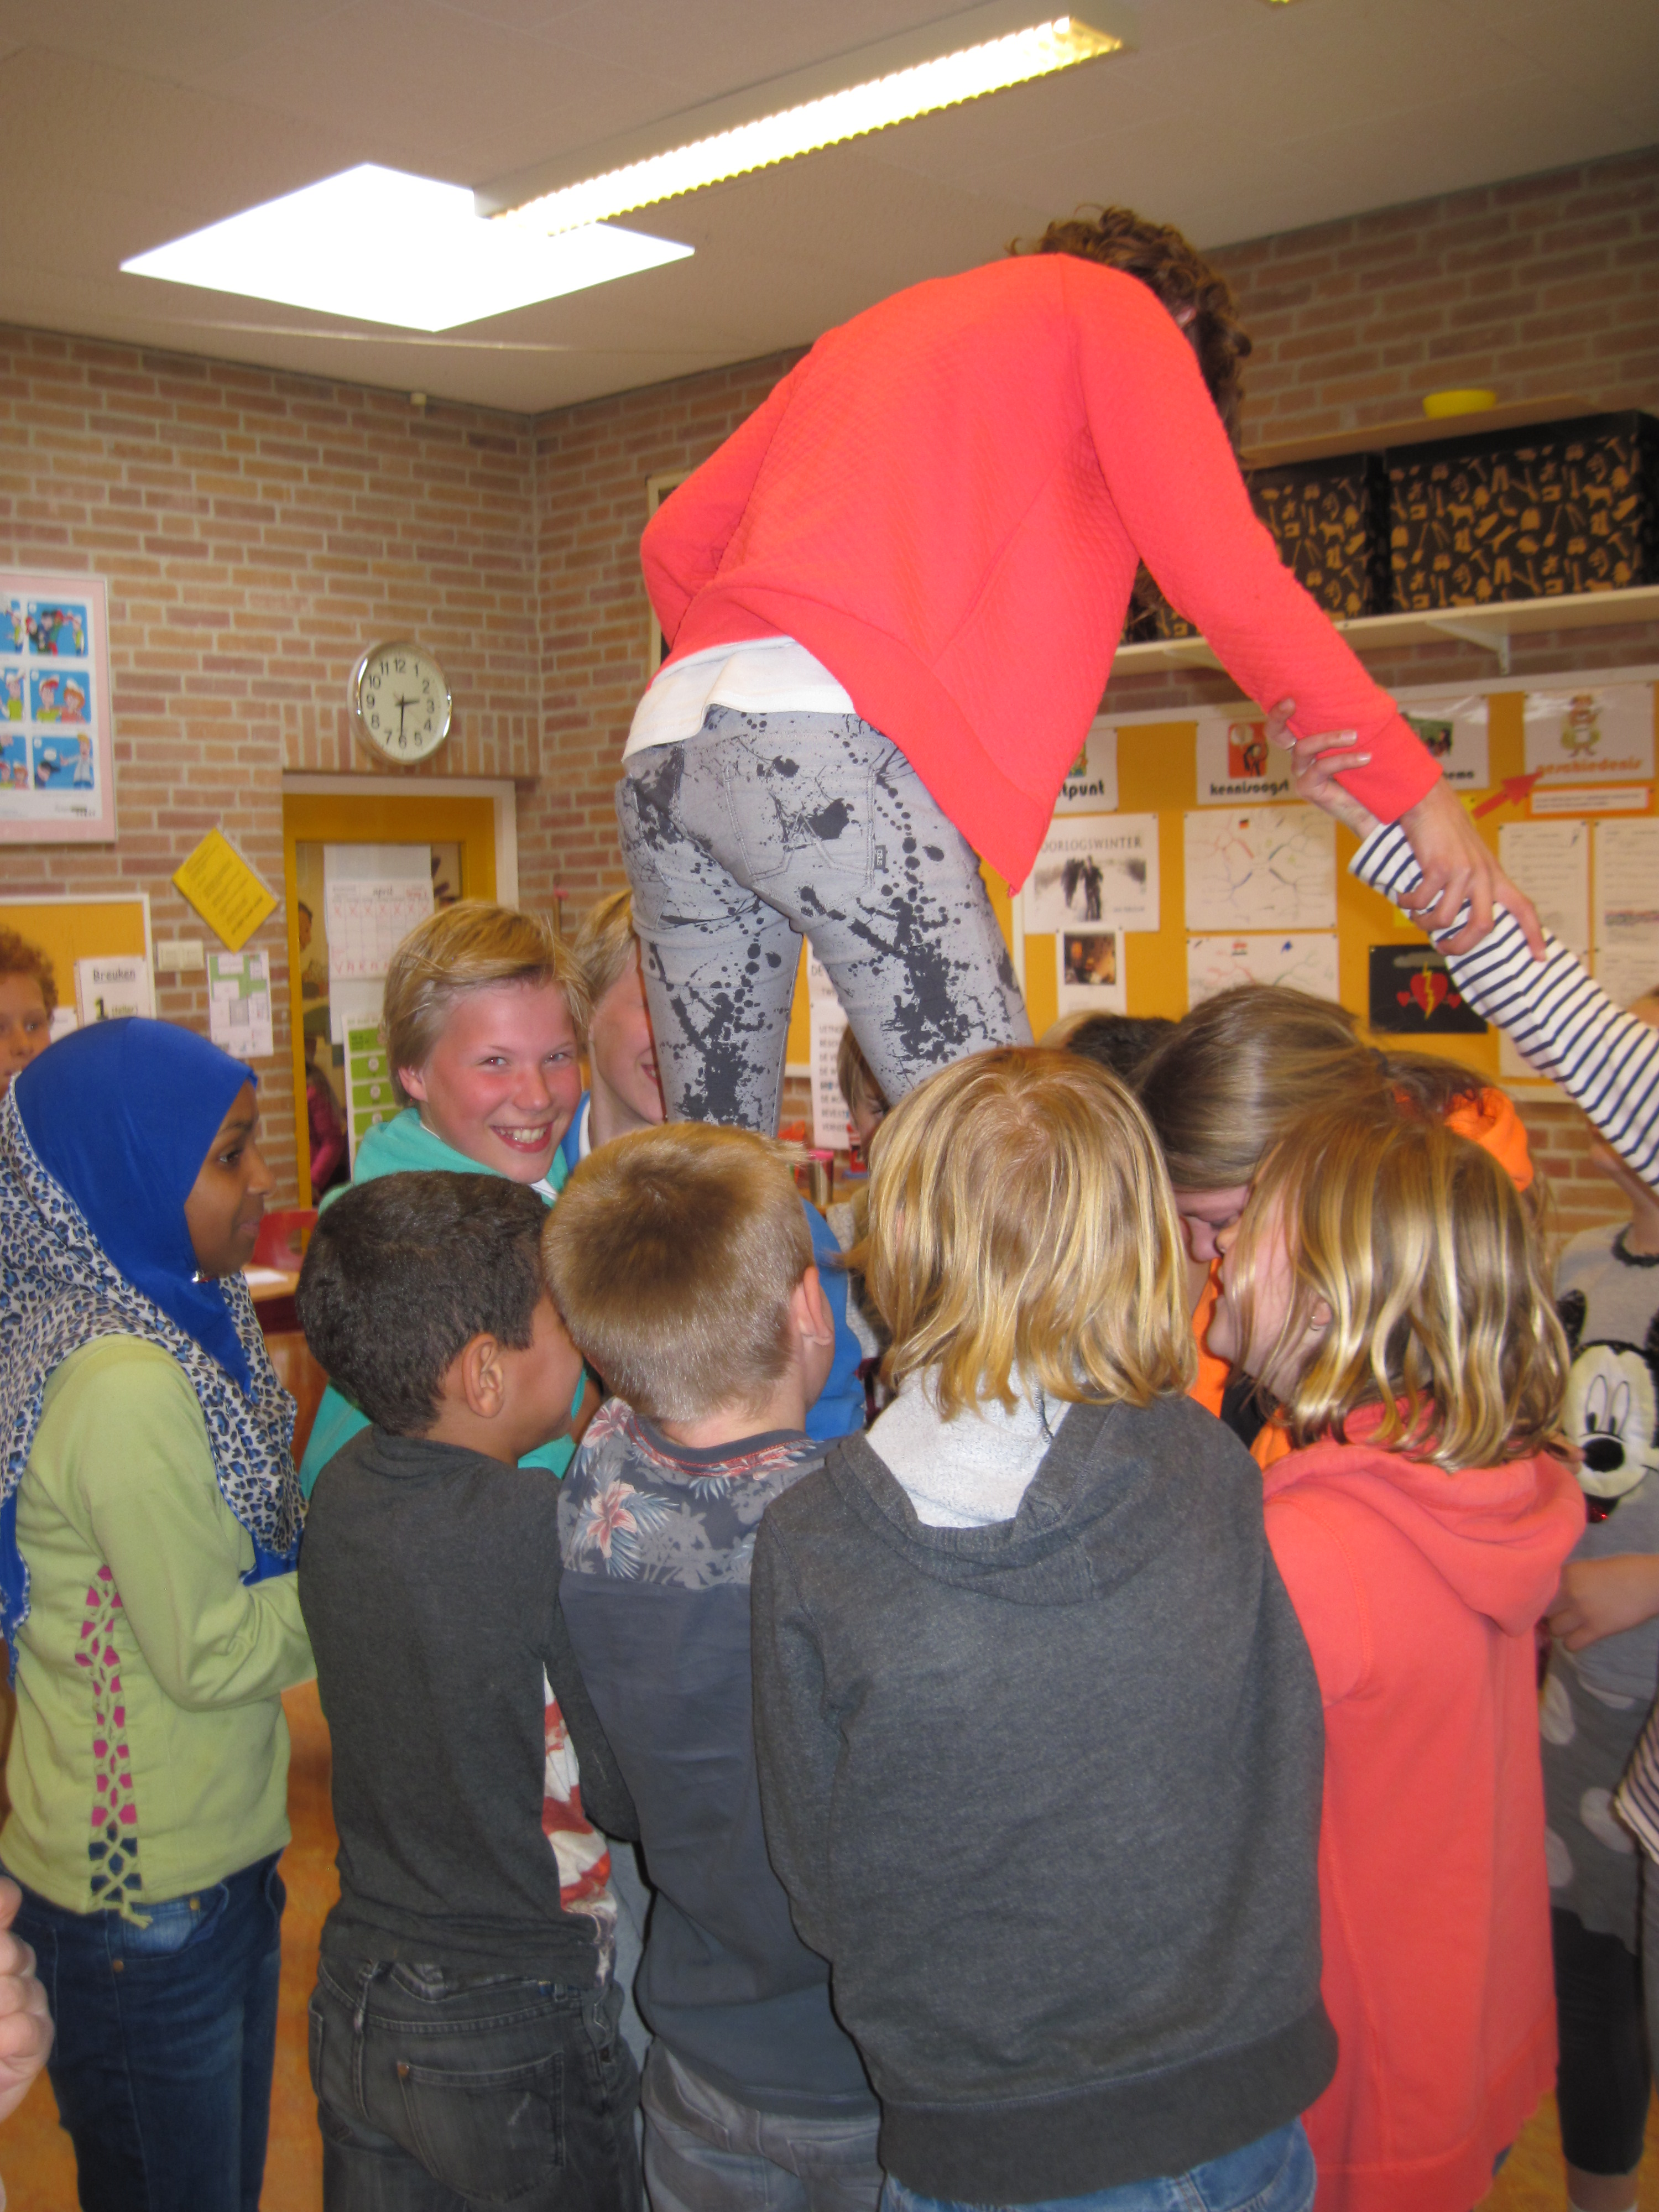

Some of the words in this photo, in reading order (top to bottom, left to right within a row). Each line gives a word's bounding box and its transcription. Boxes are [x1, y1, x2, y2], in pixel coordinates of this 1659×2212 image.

[380, 661, 389, 676] 11
[394, 658, 405, 674] 12
[369, 675, 381, 690] 10
[422, 680, 430, 693] 2
[366, 694, 375, 708] 9
[427, 699, 435, 713] 3
[371, 714, 379, 729] 8
[424, 718, 432, 732] 4
[385, 730, 392, 745] 7
[399, 734, 406, 749] 6
[414, 731, 422, 746] 5
[1057, 779, 1104, 801] tpunt
[1210, 779, 1289, 796] kennisoogst
[1041, 835, 1142, 853] OORLOGSWINTER
[93, 968, 136, 983] Breuken
